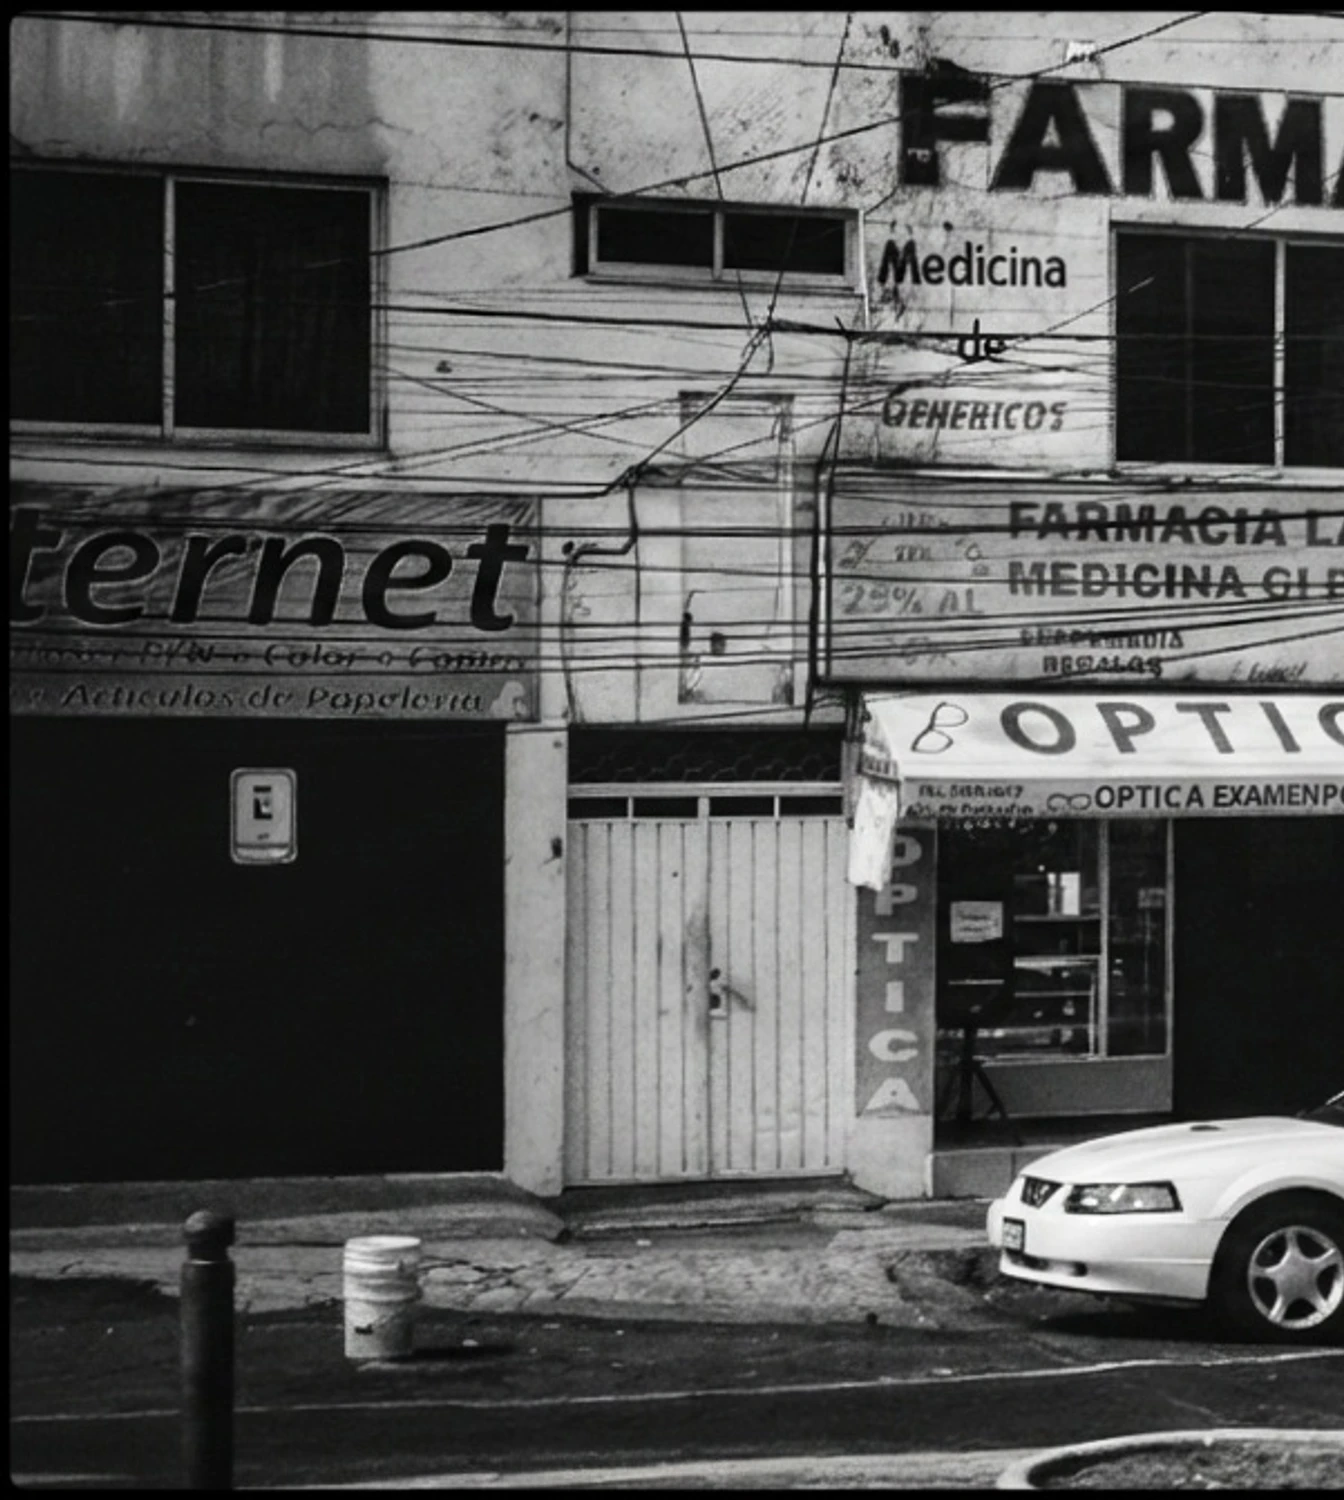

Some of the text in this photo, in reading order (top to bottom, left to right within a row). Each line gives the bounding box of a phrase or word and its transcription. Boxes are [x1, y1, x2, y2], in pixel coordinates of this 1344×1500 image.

[878, 239, 1067, 288] Medicina
[957, 318, 1007, 364] de
[1009, 501, 1287, 547] FARMACIA
[1008, 560, 1248, 600] MEDICINA
[1094, 784, 1204, 809] OPTICA
